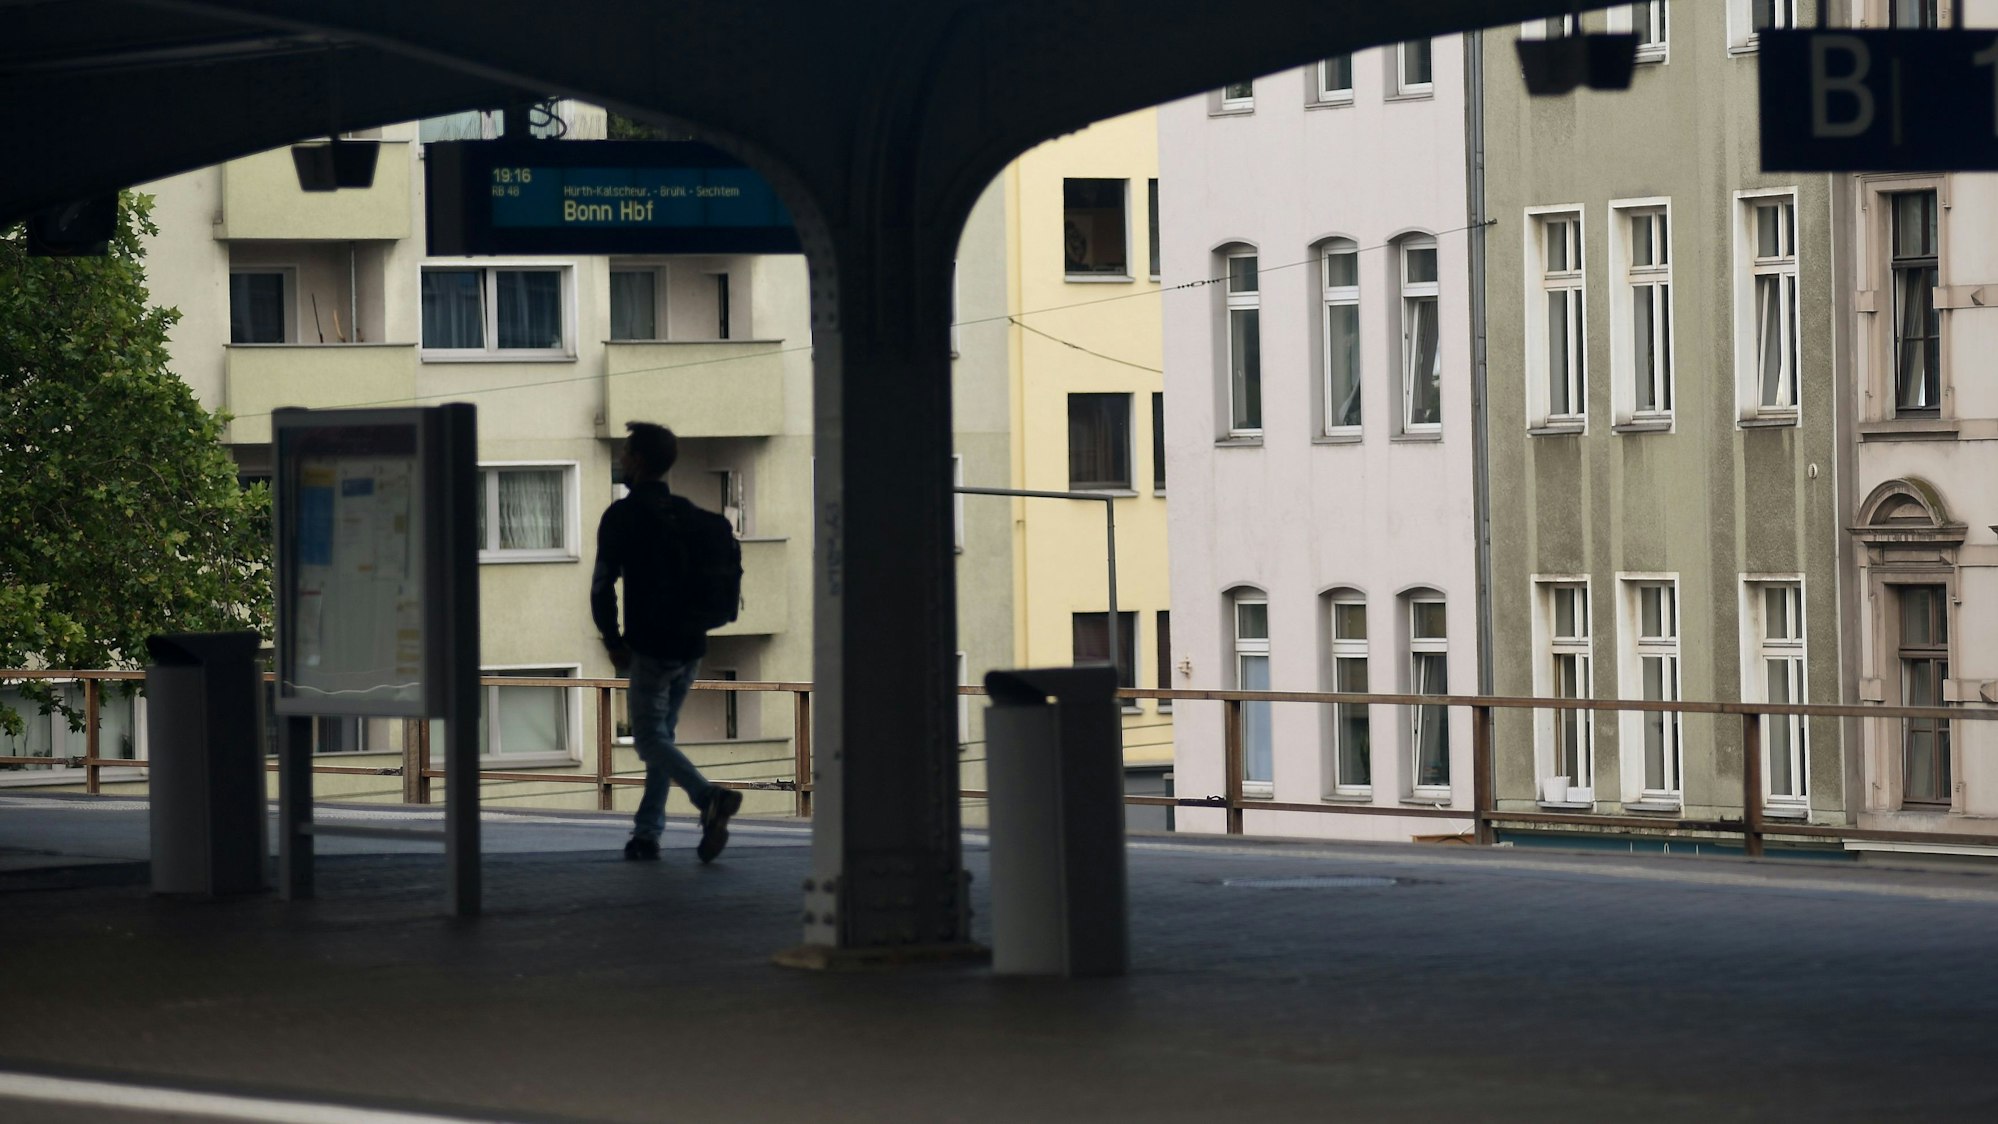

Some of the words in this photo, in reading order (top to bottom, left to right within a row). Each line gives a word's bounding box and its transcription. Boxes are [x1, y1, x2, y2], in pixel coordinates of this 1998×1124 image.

[1810, 34, 1875, 139] B
[493, 168, 532, 183] 19:16
[491, 186, 505, 197] RB
[563, 185, 651, 197] Hürth-Kalscheur.
[659, 185, 687, 197] Brühl
[695, 185, 740, 197] Sechtem
[563, 200, 613, 221] Bonn
[619, 200, 654, 221] Hbf
